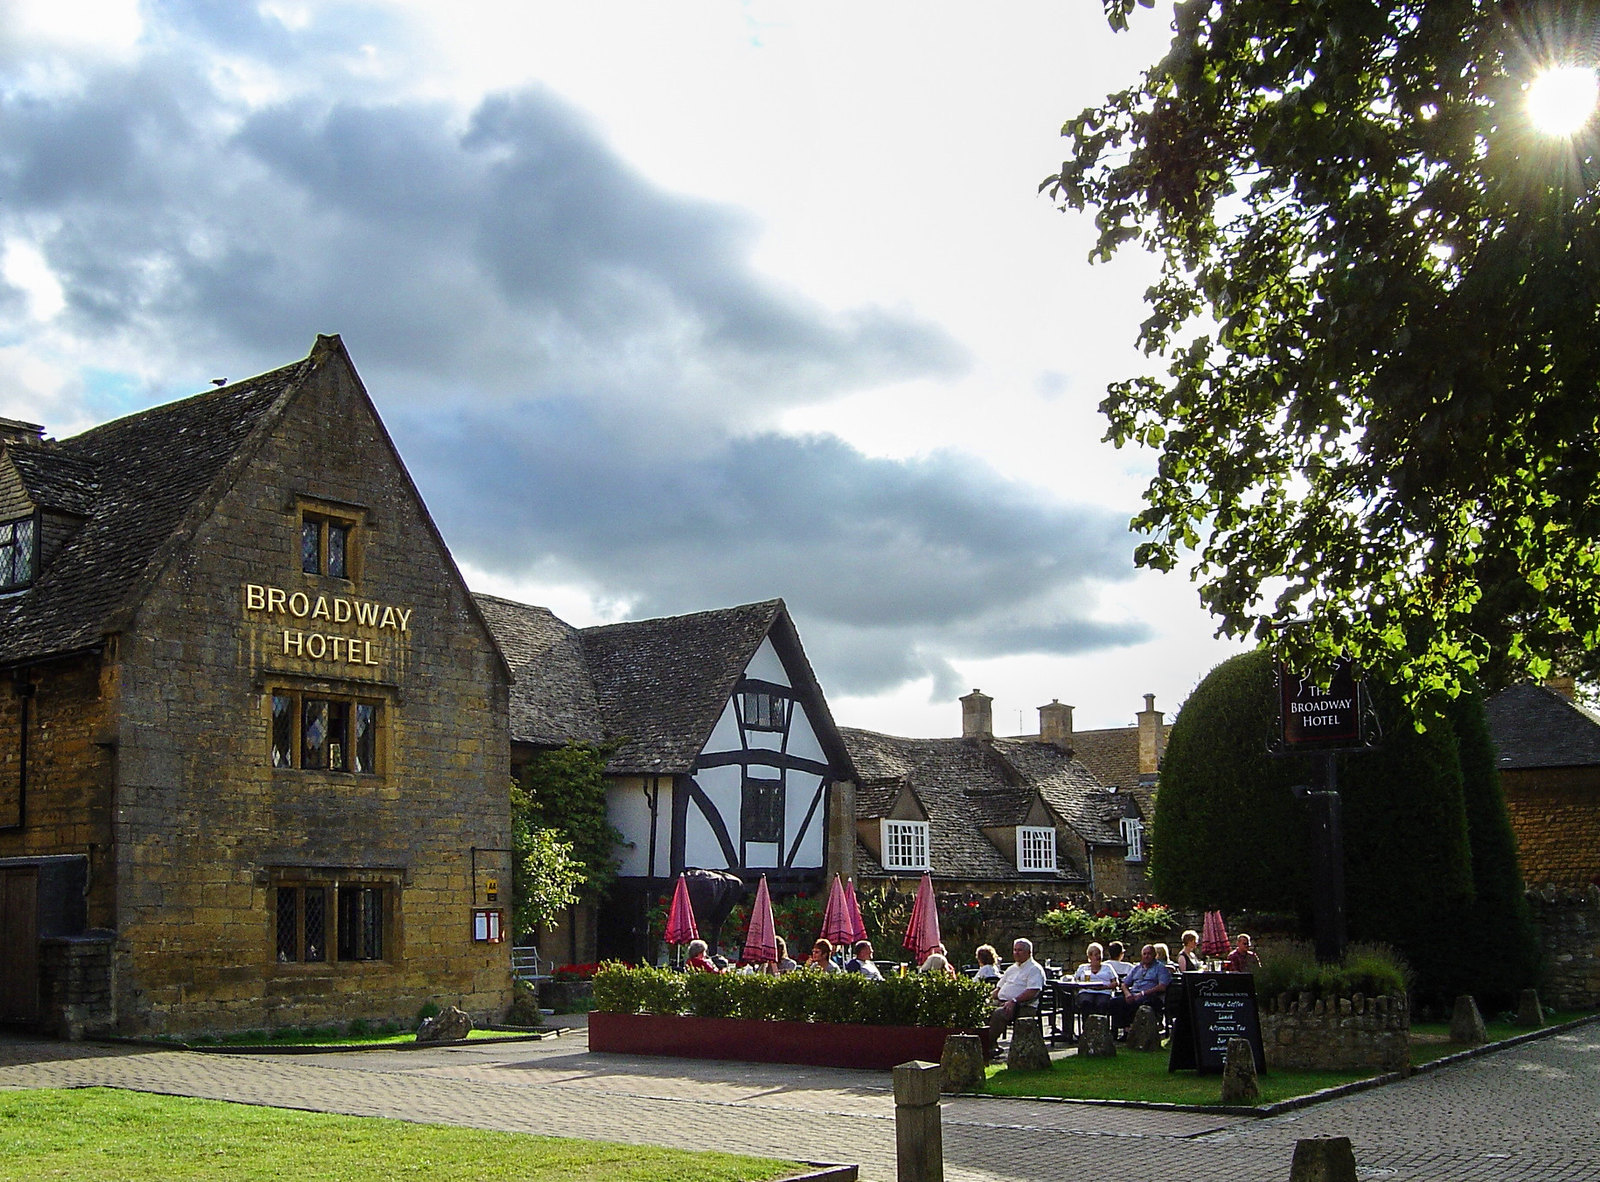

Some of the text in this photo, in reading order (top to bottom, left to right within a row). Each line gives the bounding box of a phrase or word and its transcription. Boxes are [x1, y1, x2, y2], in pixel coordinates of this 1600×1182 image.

[246, 583, 412, 631] BROADWAY
[283, 630, 379, 665] HOTEL
[1291, 699, 1352, 713] BROADWAY
[1303, 715, 1341, 727] HOTEL
[1204, 1000, 1225, 1008] Morning
